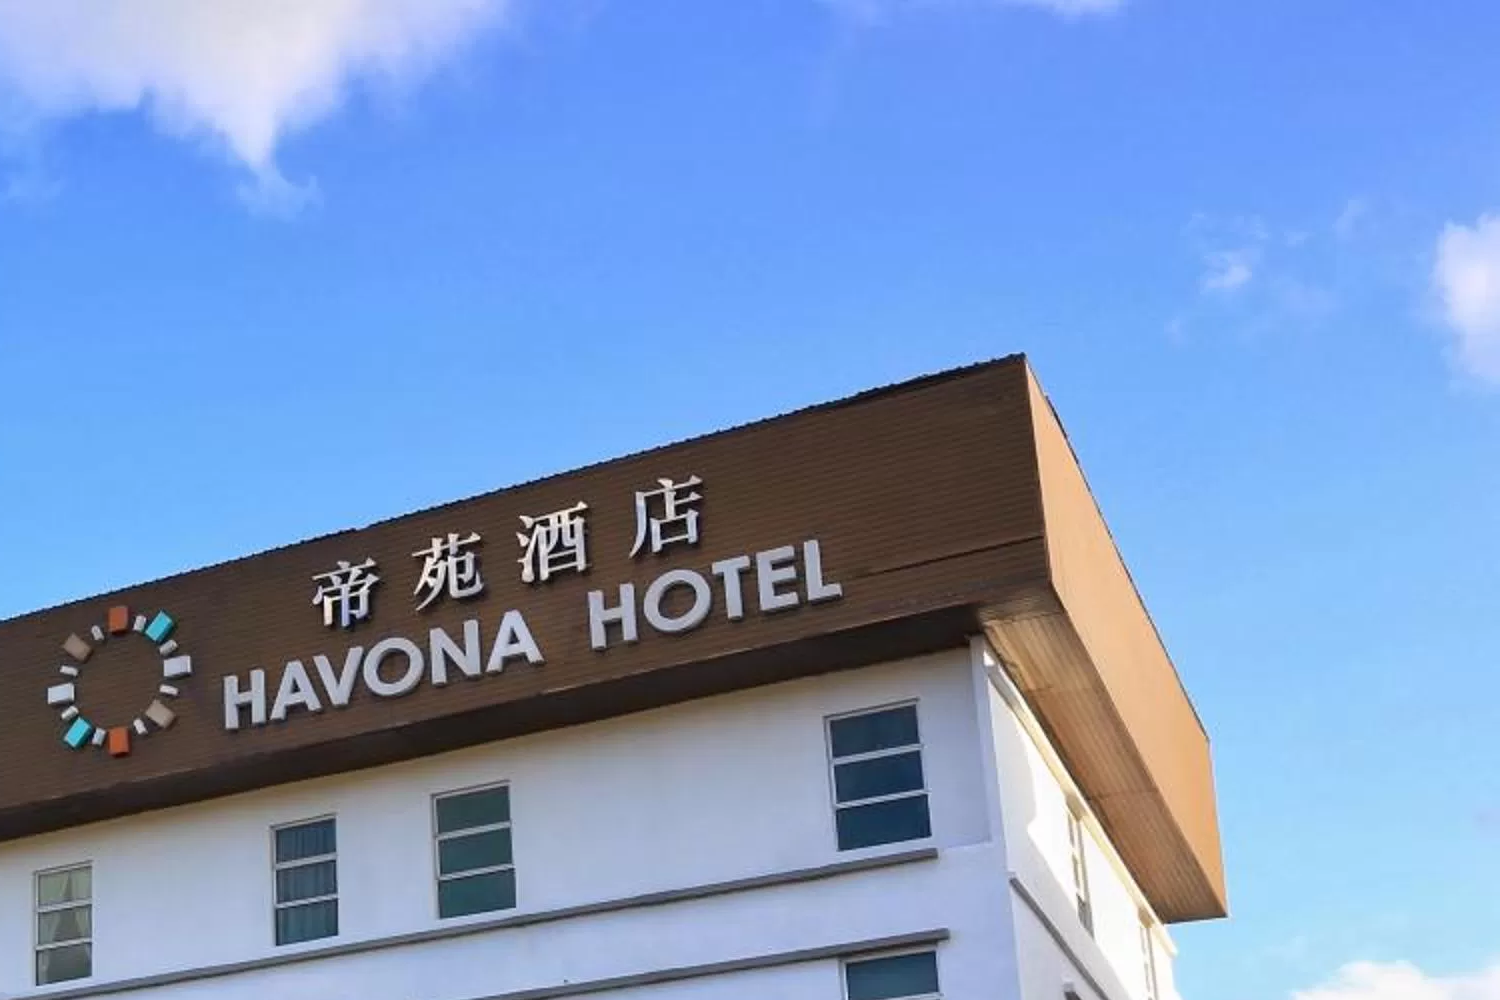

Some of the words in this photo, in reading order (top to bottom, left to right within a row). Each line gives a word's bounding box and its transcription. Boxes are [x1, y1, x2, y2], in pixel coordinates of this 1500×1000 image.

[223, 609, 544, 731] HAVONA
[588, 540, 843, 651] HOTEL
[311, 475, 704, 629] 帝苑酒店
